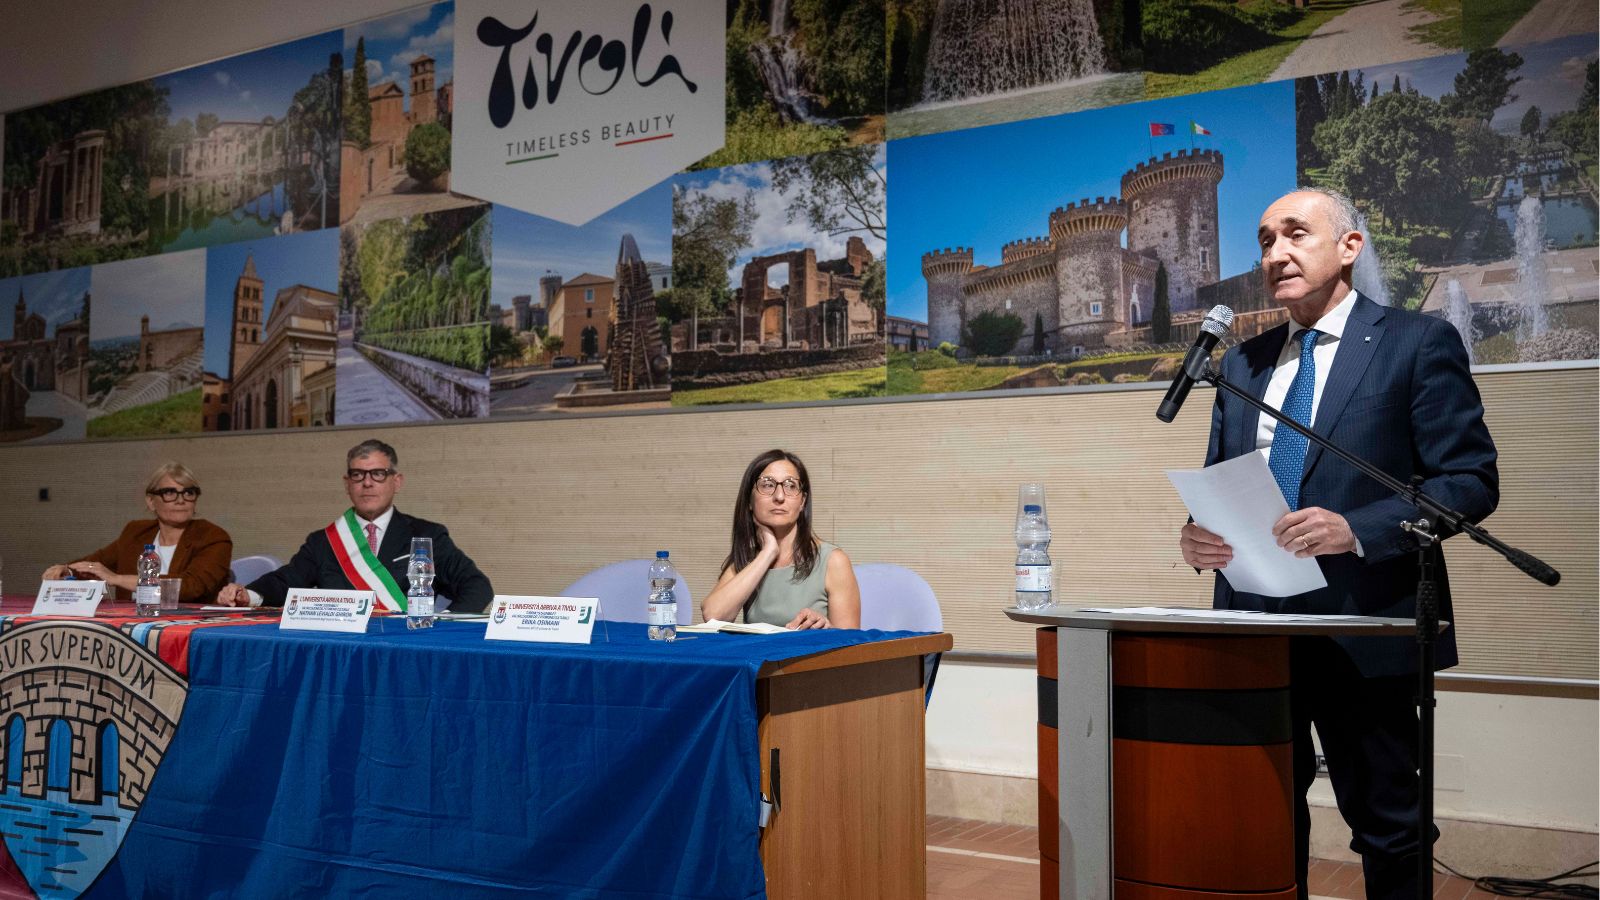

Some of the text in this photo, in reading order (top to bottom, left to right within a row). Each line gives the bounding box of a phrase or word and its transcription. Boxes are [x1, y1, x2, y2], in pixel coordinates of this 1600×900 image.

[476, 3, 698, 129] Tivoli
[506, 113, 675, 157] TIMELESS BEAUTY
[40, 631, 155, 699] SUPERBUM
